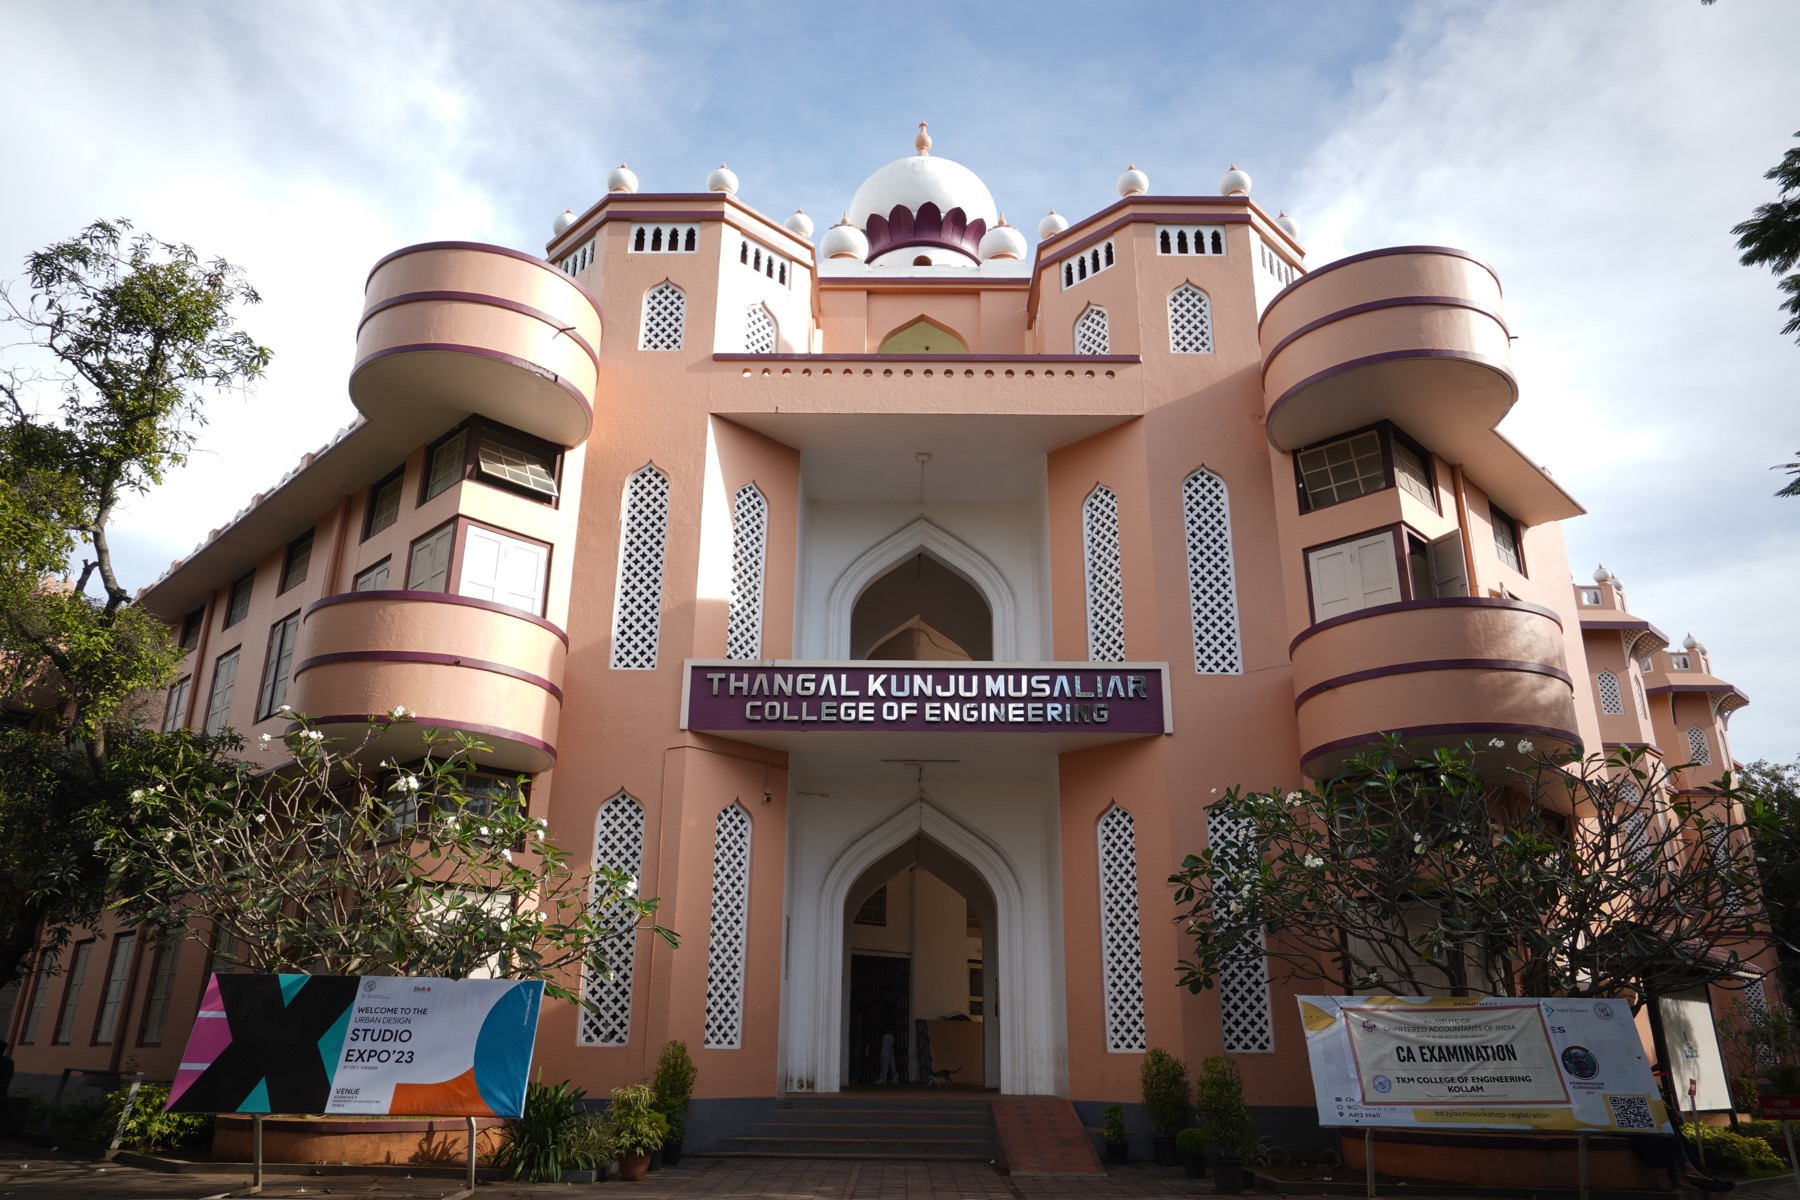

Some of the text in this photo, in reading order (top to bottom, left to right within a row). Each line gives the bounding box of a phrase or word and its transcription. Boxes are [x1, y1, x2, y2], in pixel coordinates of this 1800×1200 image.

[706, 673, 1148, 698] THANGAL KUNJU MUSALIAR
[745, 701, 1109, 724] COLLEGE OF ENGINEERING
[350, 1028, 412, 1042] STUDIO
[344, 1049, 414, 1064] EXPO'23
[1396, 1044, 1518, 1062] CA EXAMINATION
[1434, 1110, 1552, 1119] bit.ly/acmworkshop-registration
